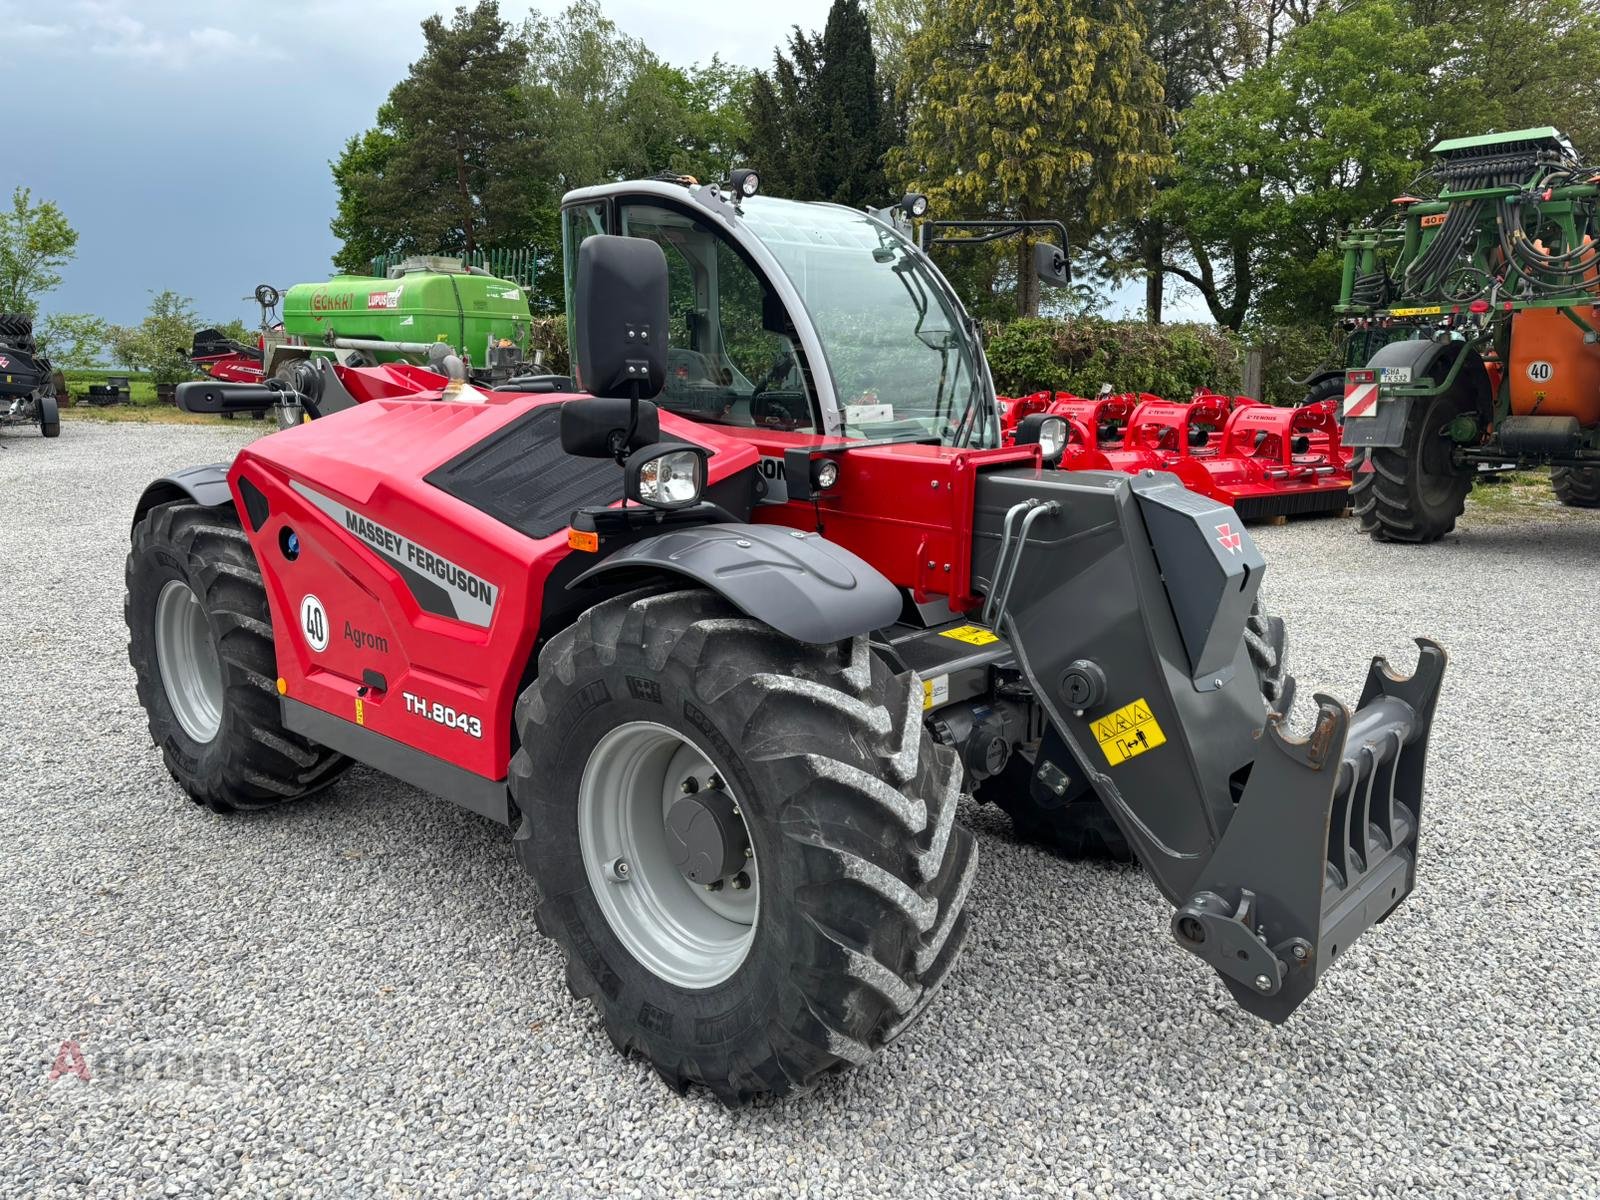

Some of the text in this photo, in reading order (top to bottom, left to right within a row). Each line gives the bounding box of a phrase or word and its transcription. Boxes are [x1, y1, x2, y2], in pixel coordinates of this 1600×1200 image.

[1531, 364, 1548, 378] 40
[346, 510, 492, 606] MASSEY FERGUSON
[307, 605, 324, 642] 40
[344, 621, 388, 653] Agrom
[402, 691, 482, 739] TH.8043
